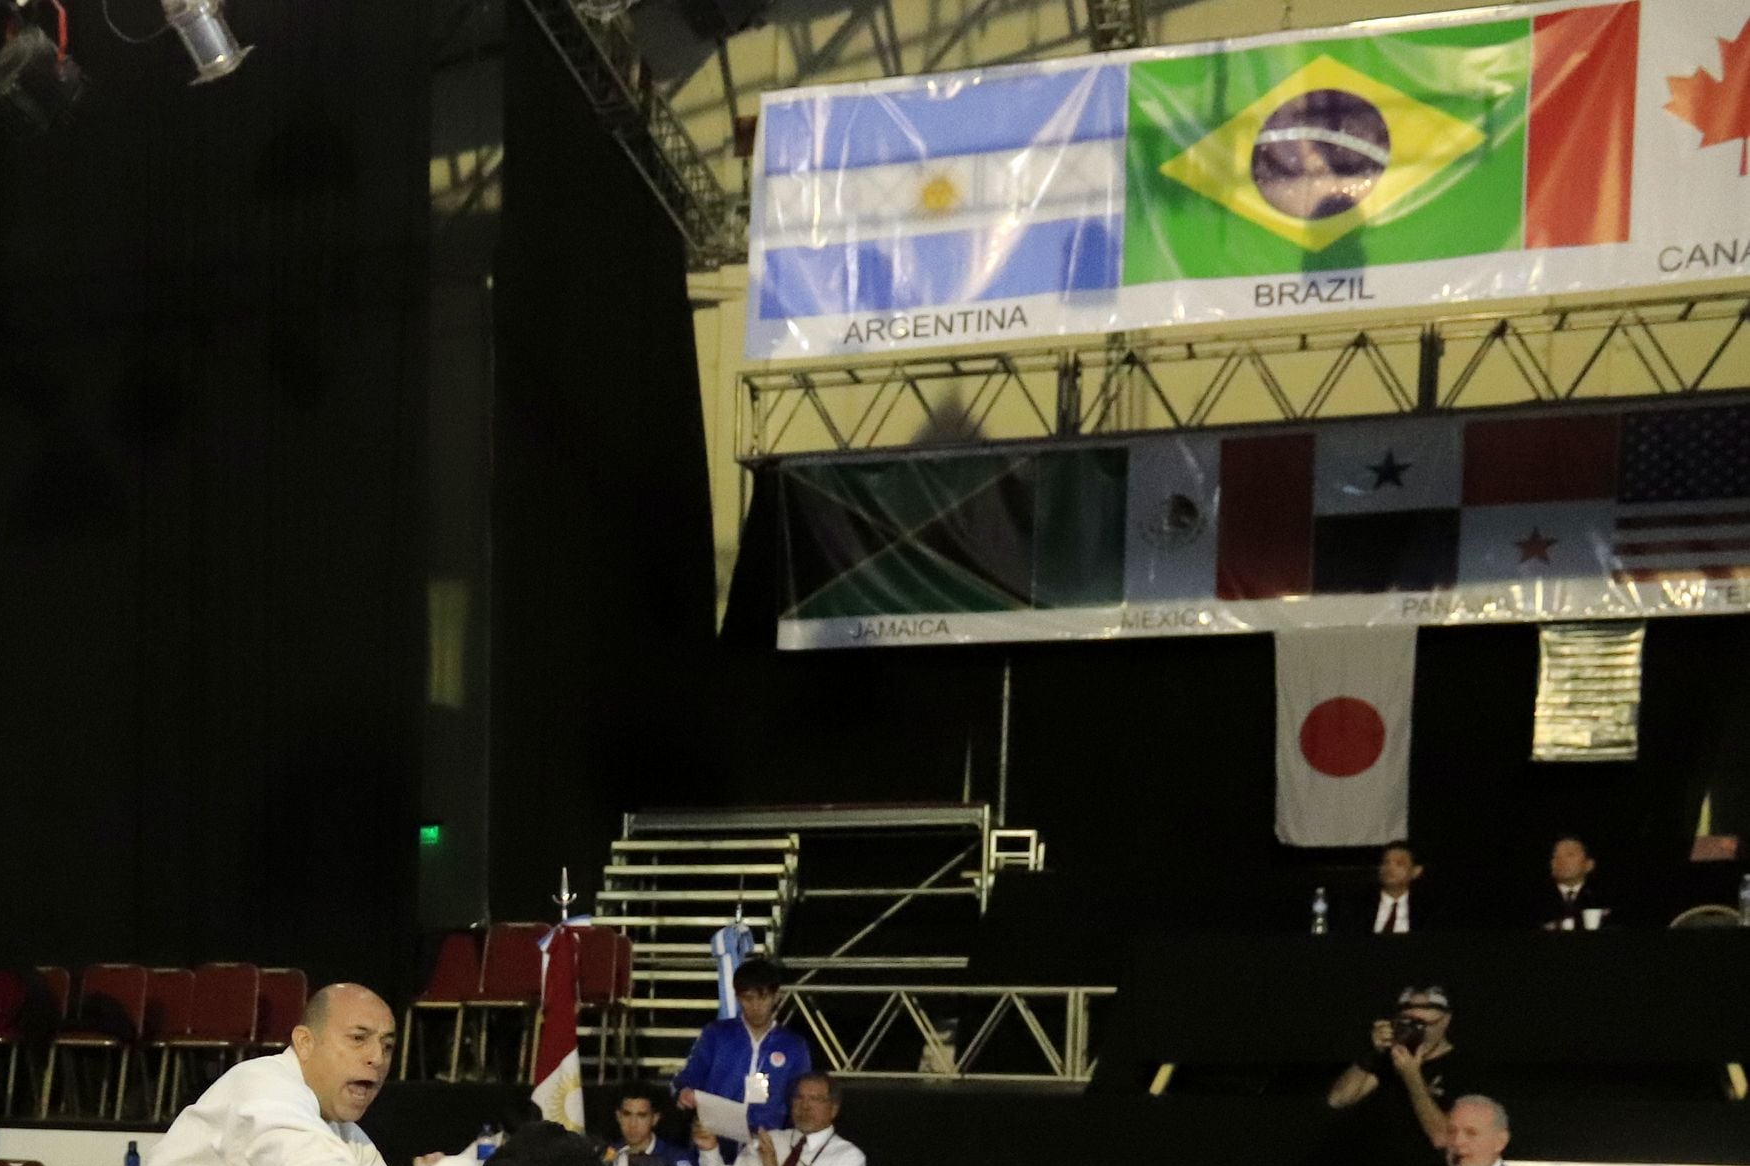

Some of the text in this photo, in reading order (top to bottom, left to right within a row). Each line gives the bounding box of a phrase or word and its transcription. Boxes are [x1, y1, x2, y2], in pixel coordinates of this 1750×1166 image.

[1254, 275, 1375, 308] BRAZIL
[842, 304, 1028, 345] ARGENTINA
[852, 618, 950, 639] JAMAICA
